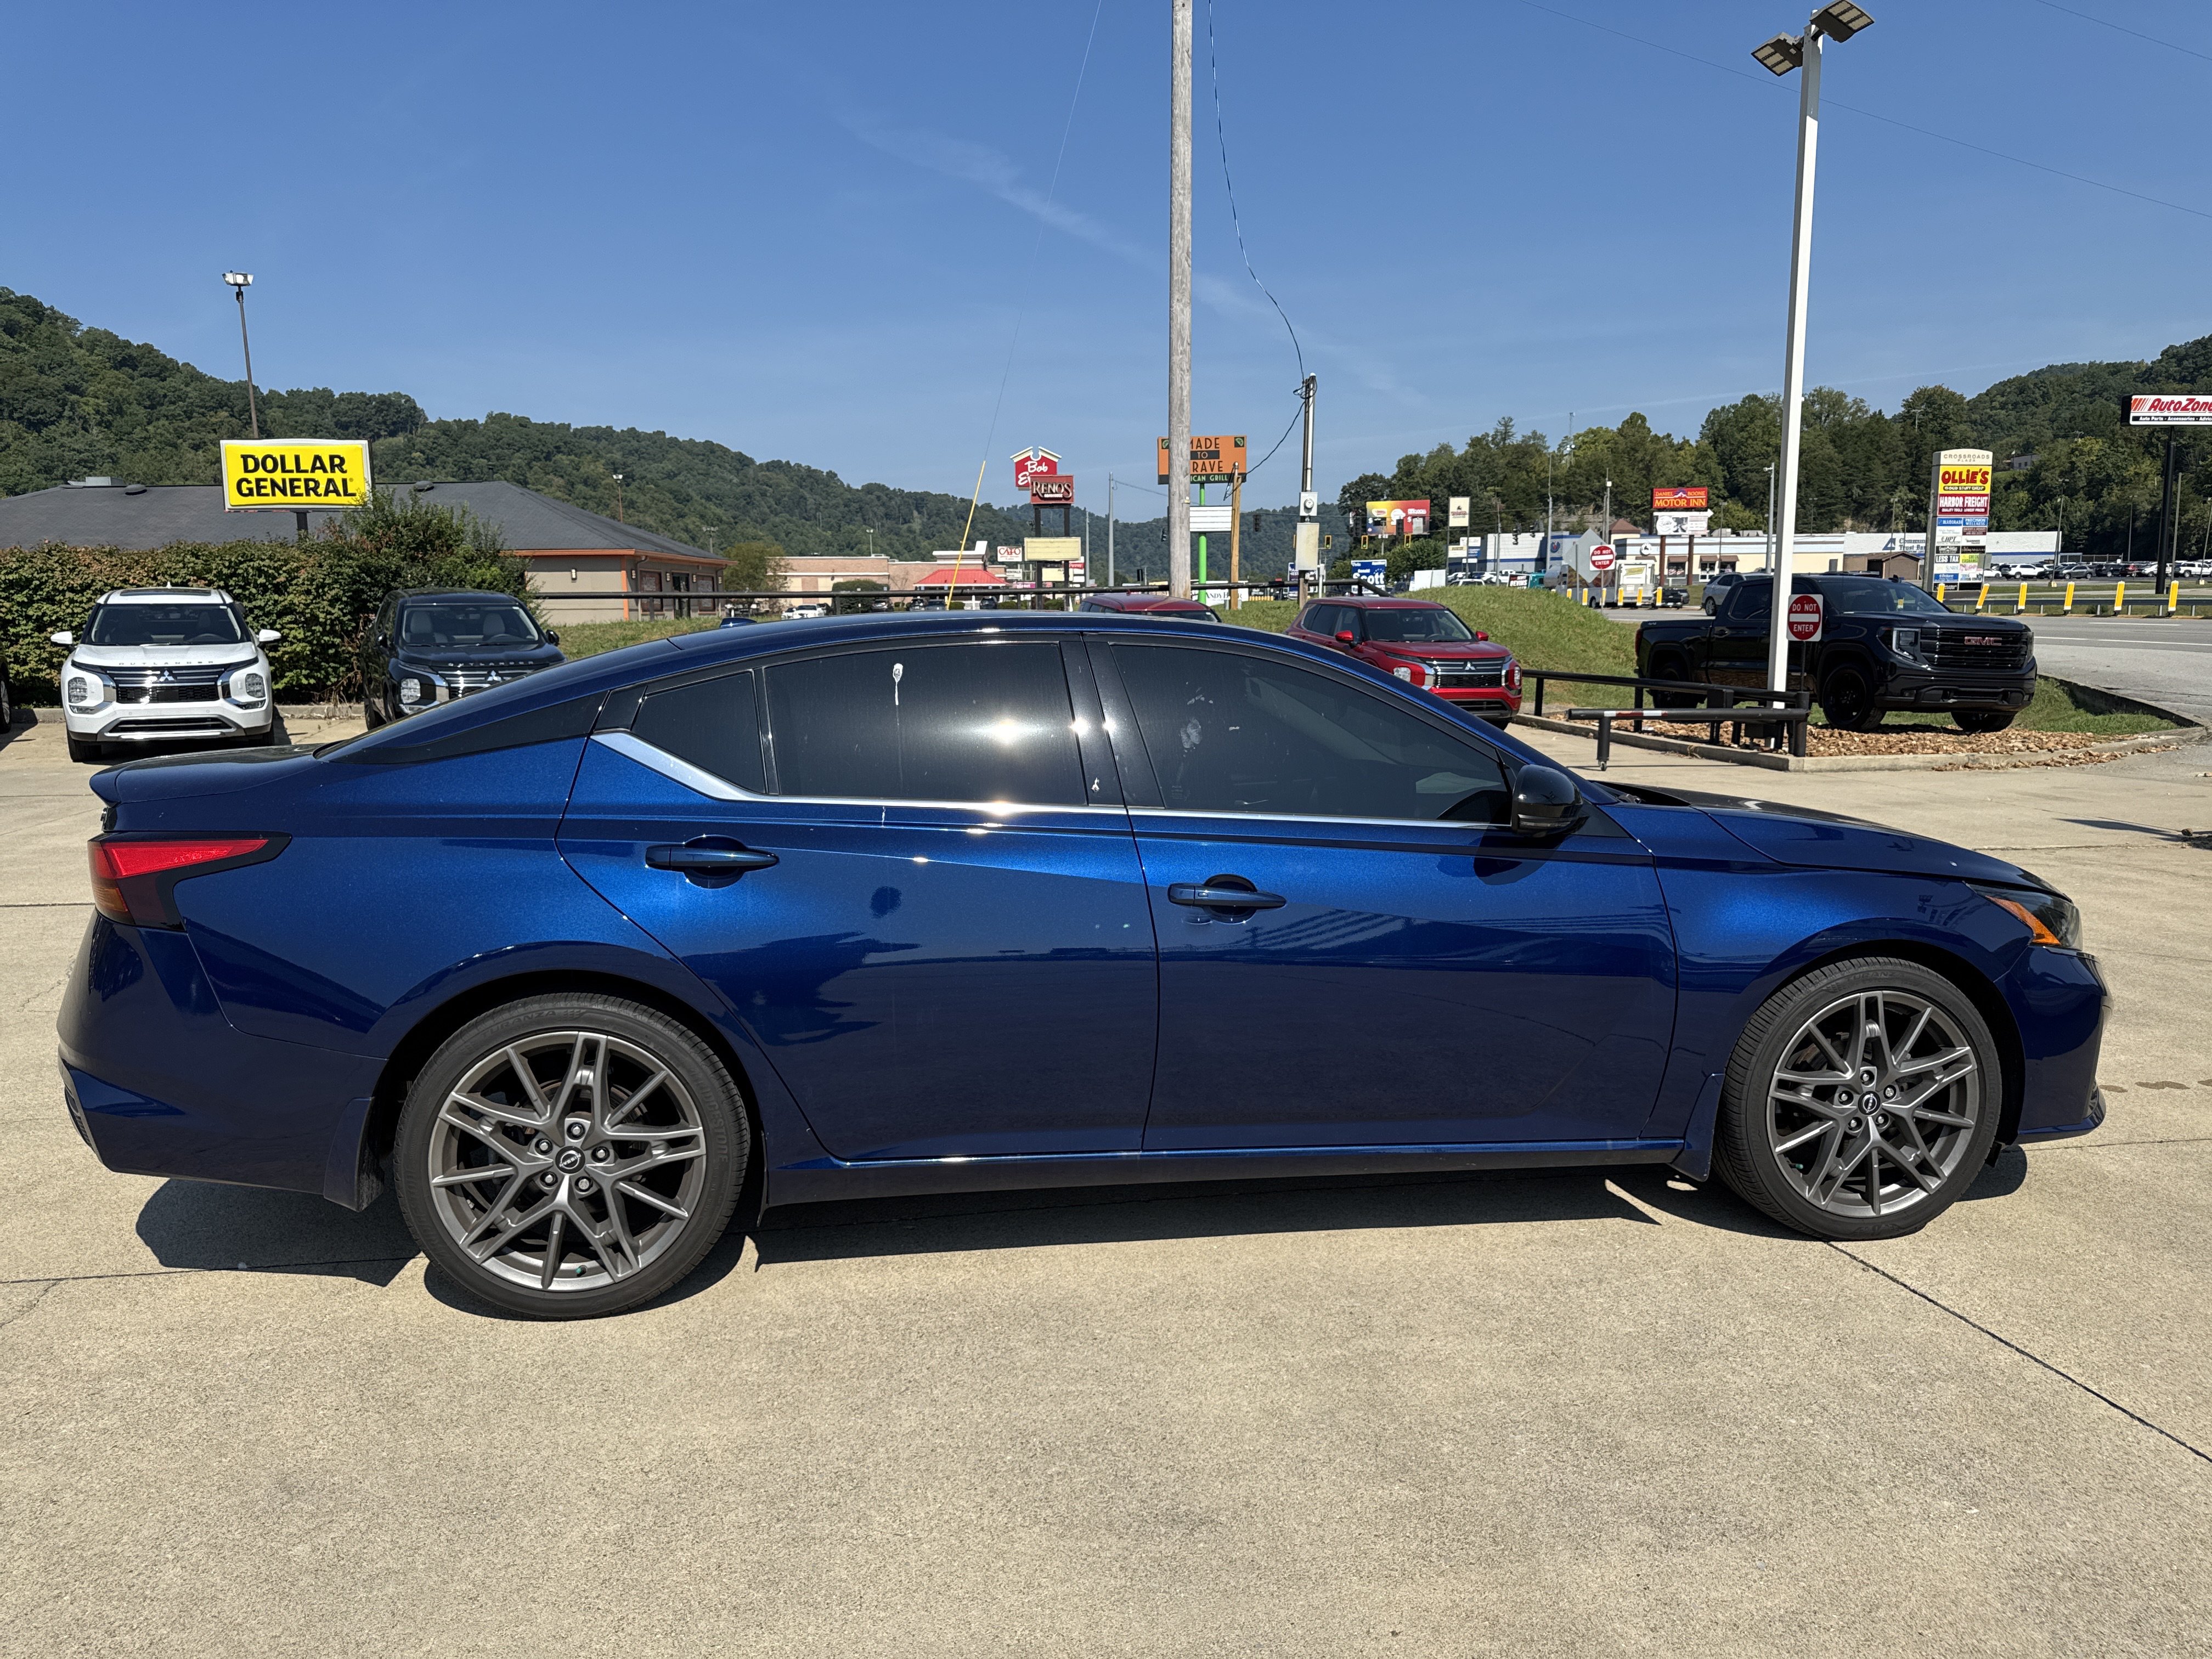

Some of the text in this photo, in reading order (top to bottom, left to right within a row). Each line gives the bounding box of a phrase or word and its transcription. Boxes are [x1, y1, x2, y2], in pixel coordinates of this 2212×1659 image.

[240, 454, 347, 474] DOLLAR
[1024, 461, 1048, 472] Bob
[236, 477, 357, 498] GENERAL
[1690, 498, 1706, 506] INN
[1940, 496, 1988, 507] HARBOR FREIGHT
[1965, 636, 2002, 646] GMC
[482, 1010, 556, 1037] TURANZA
[558, 1153, 582, 1167] NISSAN
